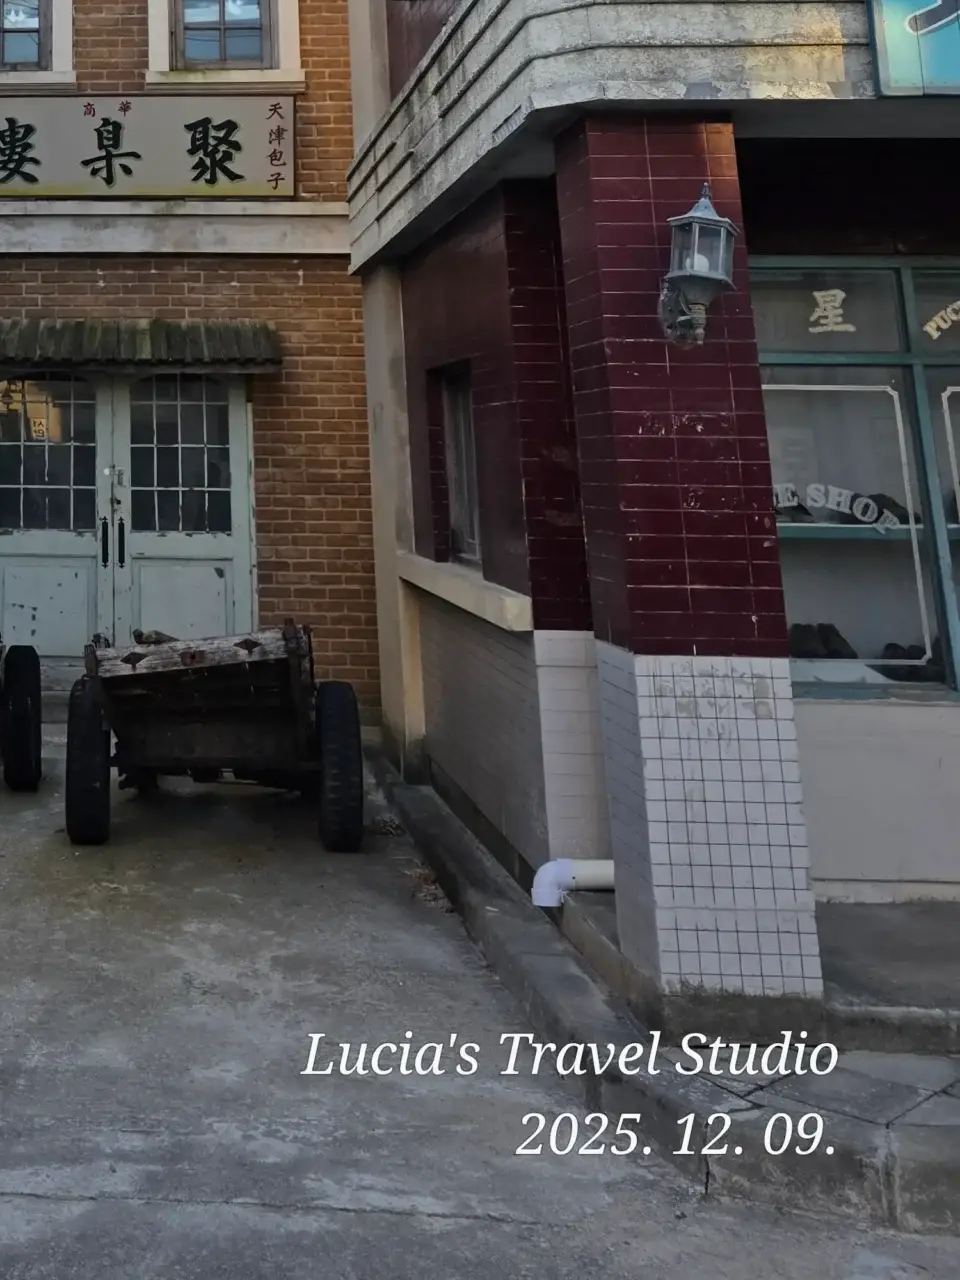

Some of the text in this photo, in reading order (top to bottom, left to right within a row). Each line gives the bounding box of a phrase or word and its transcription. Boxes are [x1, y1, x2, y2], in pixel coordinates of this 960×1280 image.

[265, 102, 289, 191] 天津包子
[809, 288, 856, 333] 星
[806, 483, 900, 535] SHOP
